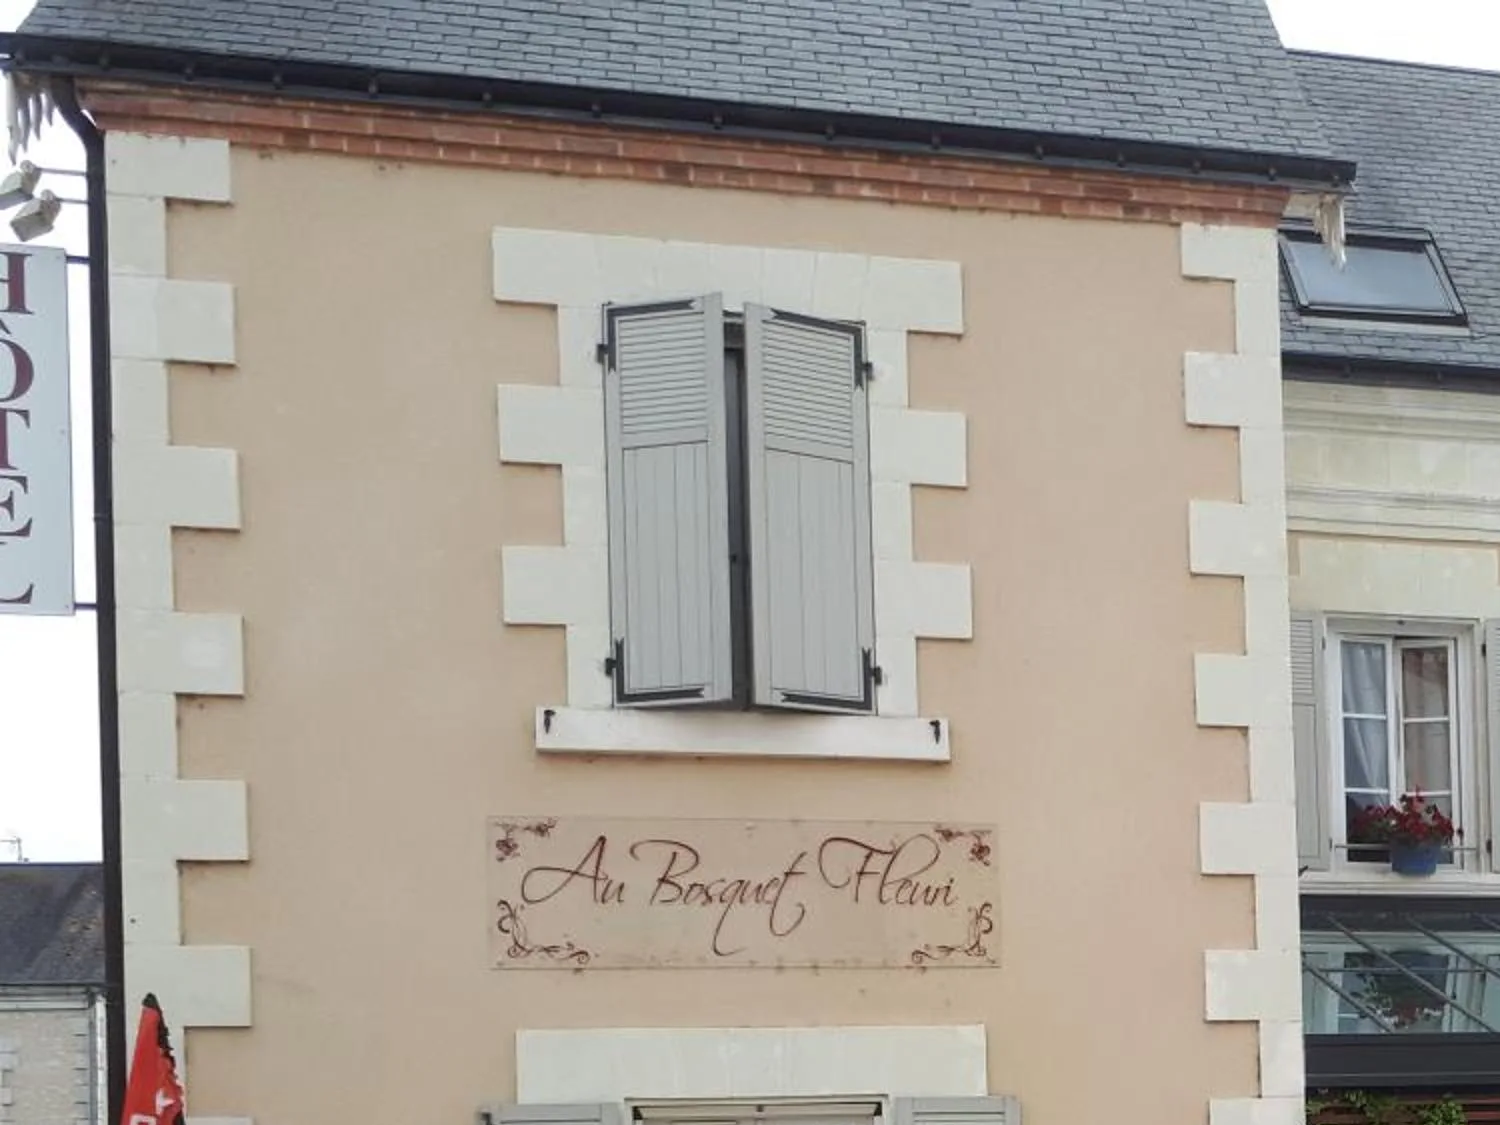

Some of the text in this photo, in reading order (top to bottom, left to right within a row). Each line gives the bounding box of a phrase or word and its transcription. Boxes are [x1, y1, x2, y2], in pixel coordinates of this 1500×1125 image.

[521, 834, 958, 956] Au Bosquet Fleuri
